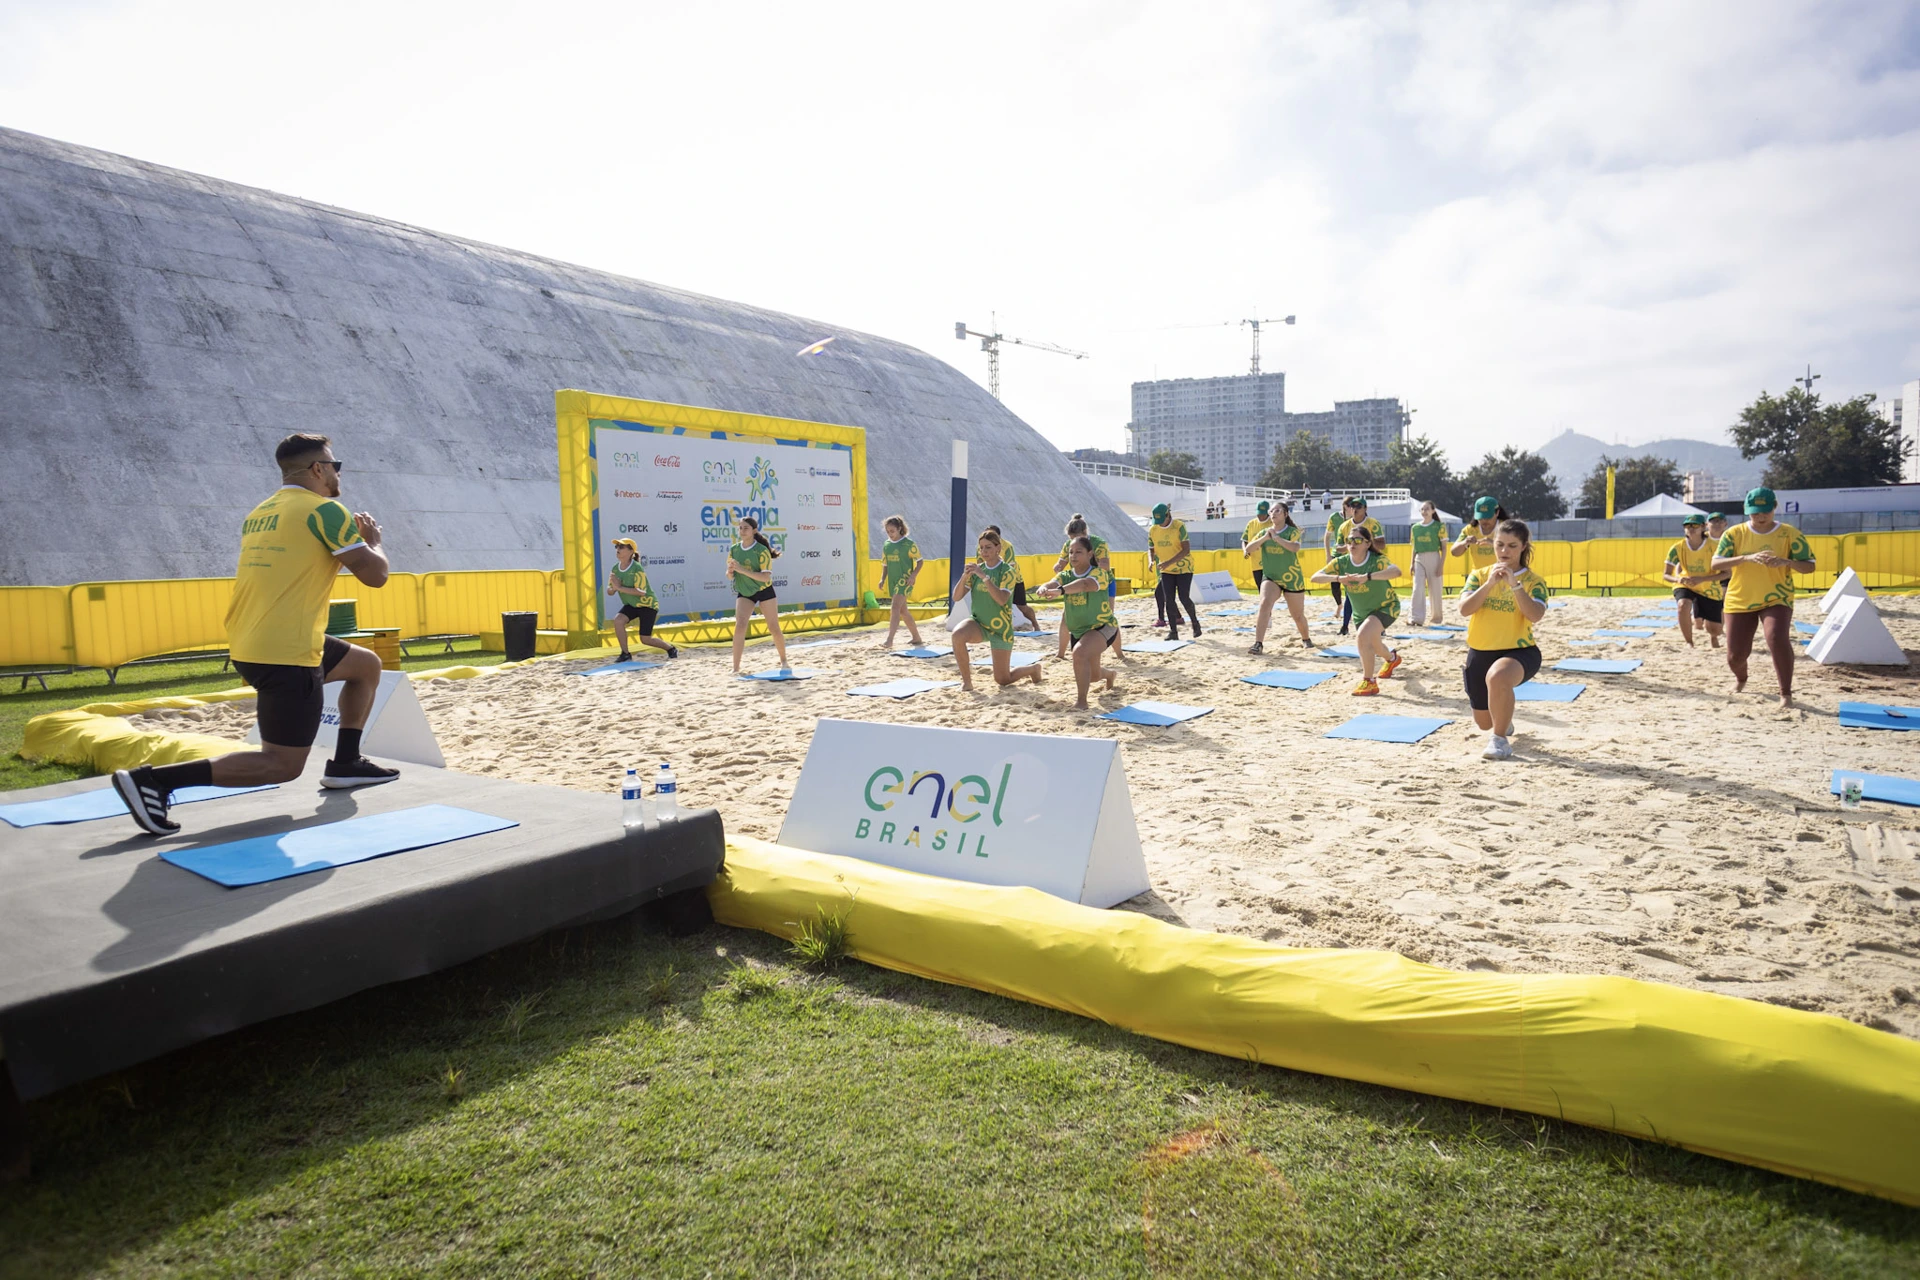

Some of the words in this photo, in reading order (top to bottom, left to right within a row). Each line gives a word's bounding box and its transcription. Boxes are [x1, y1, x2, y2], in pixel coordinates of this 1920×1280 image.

[614, 451, 640, 463] enel
[703, 459, 737, 476] enel
[701, 500, 779, 531] energia
[242, 514, 279, 536] ATLETA
[628, 524, 649, 533] PECK
[702, 527, 730, 542] para
[806, 550, 821, 558] PECK
[864, 763, 1013, 827] enel
[855, 818, 989, 858] BRASIL
